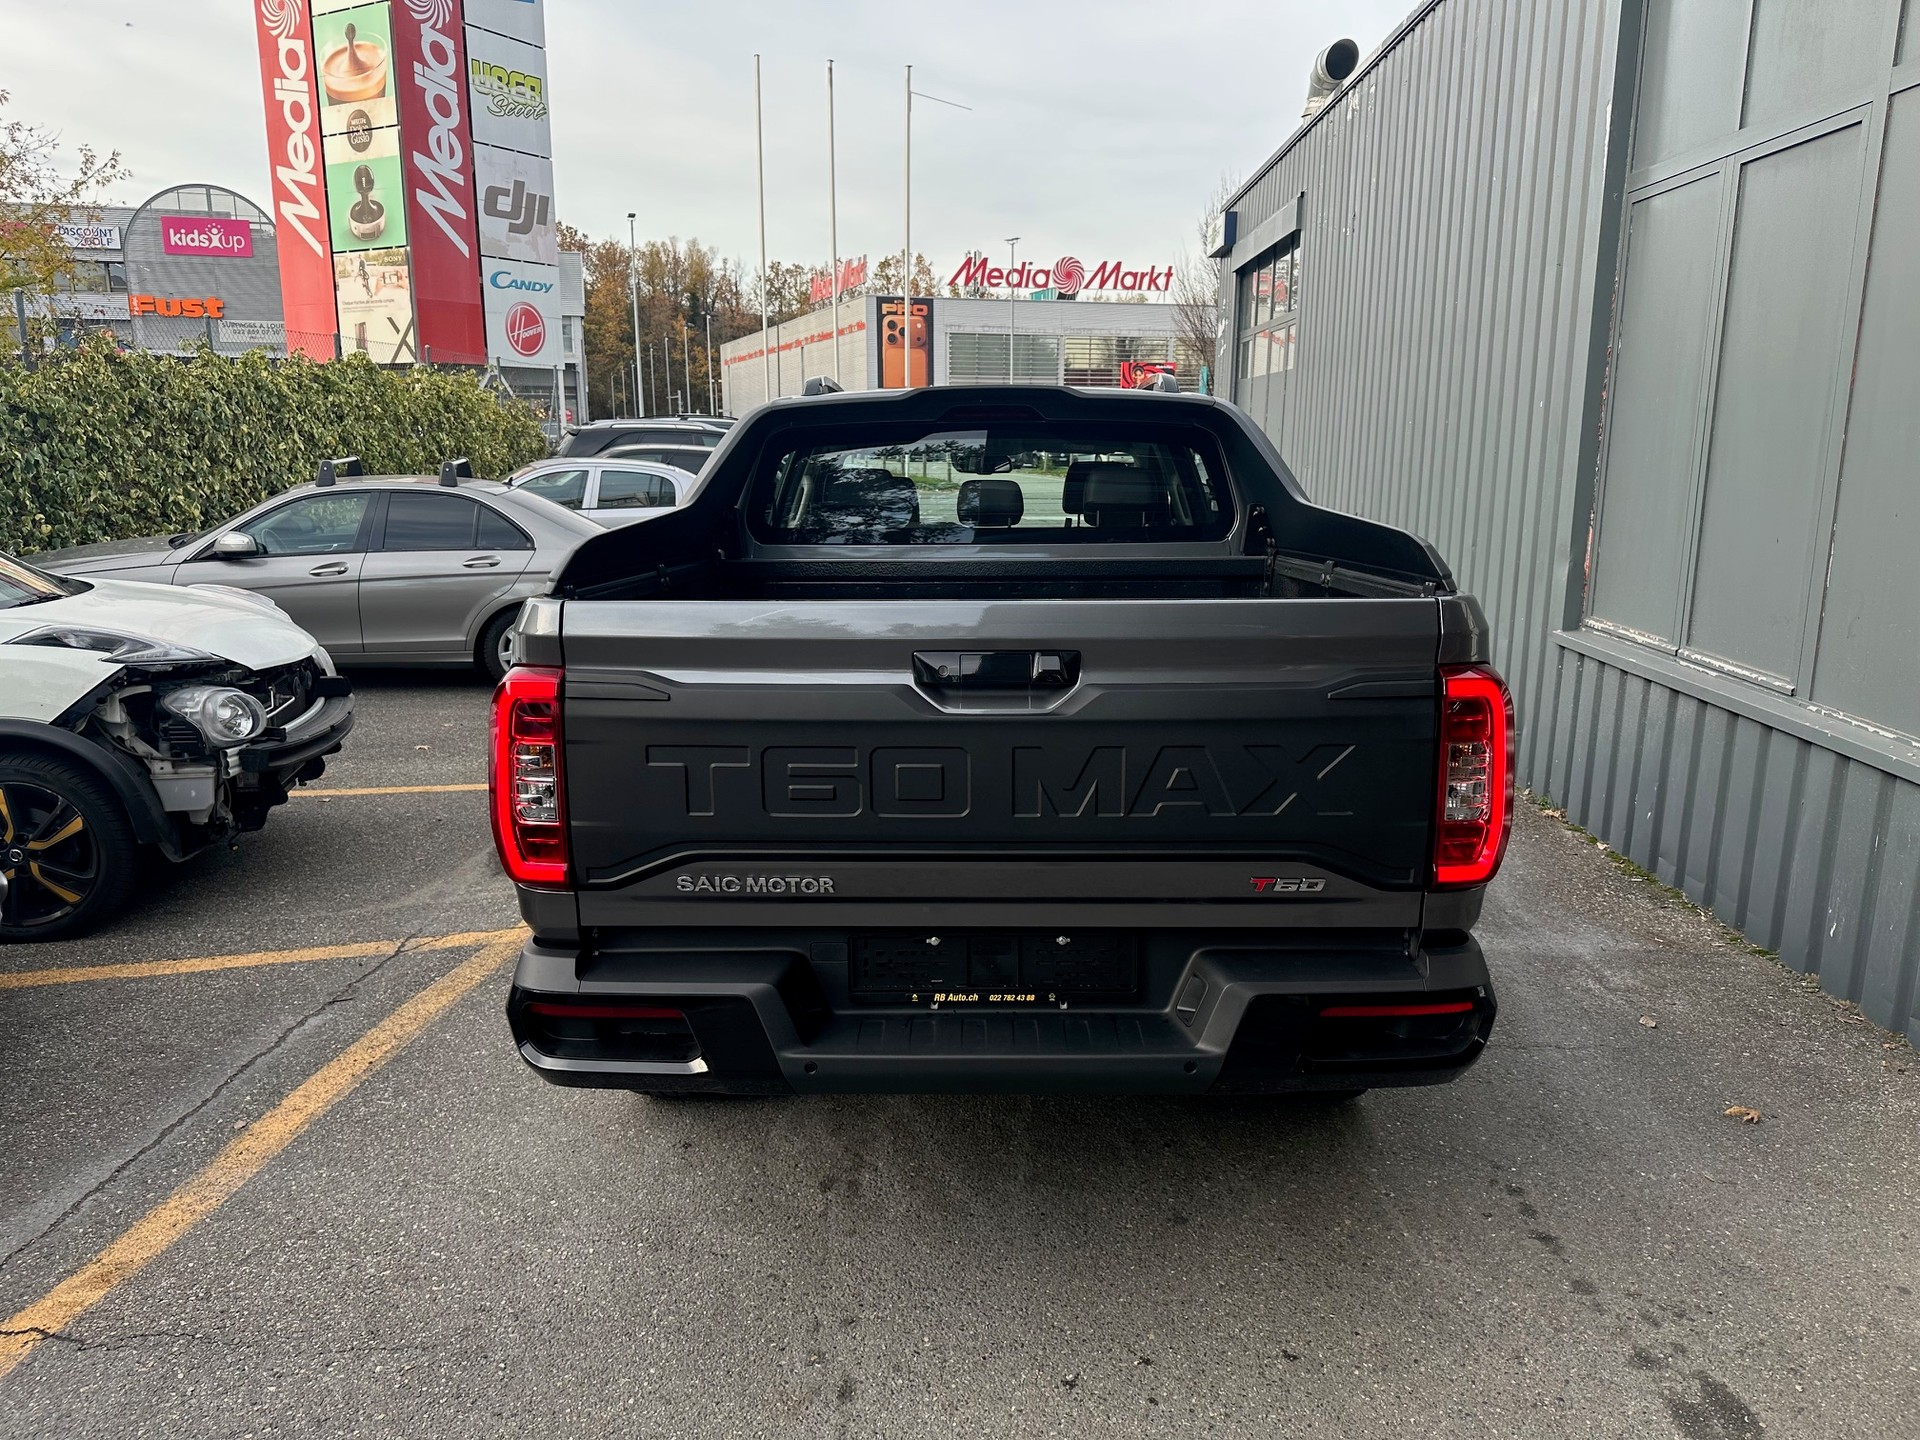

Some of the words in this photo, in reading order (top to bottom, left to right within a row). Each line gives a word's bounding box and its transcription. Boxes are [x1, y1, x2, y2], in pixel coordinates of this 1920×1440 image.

[487, 94, 547, 120] Scoot
[274, 36, 323, 258] Media
[351, 136, 370, 144] Gusto
[413, 23, 469, 258] Media
[58, 226, 113, 237] DISCOUNT
[169, 228, 209, 247] kids
[222, 234, 245, 252] up
[948, 257, 1050, 288] Media
[1083, 260, 1173, 290] Markt
[882, 303, 928, 316] PRO
[645, 744, 971, 818] T60
[1011, 744, 1356, 818] MAX
[676, 875, 741, 892] SAIC
[746, 877, 835, 893] MOTOR
[1250, 877, 1326, 893] T60
[934, 993, 946, 1001] RB
[947, 993, 979, 1001] Auto.ch
